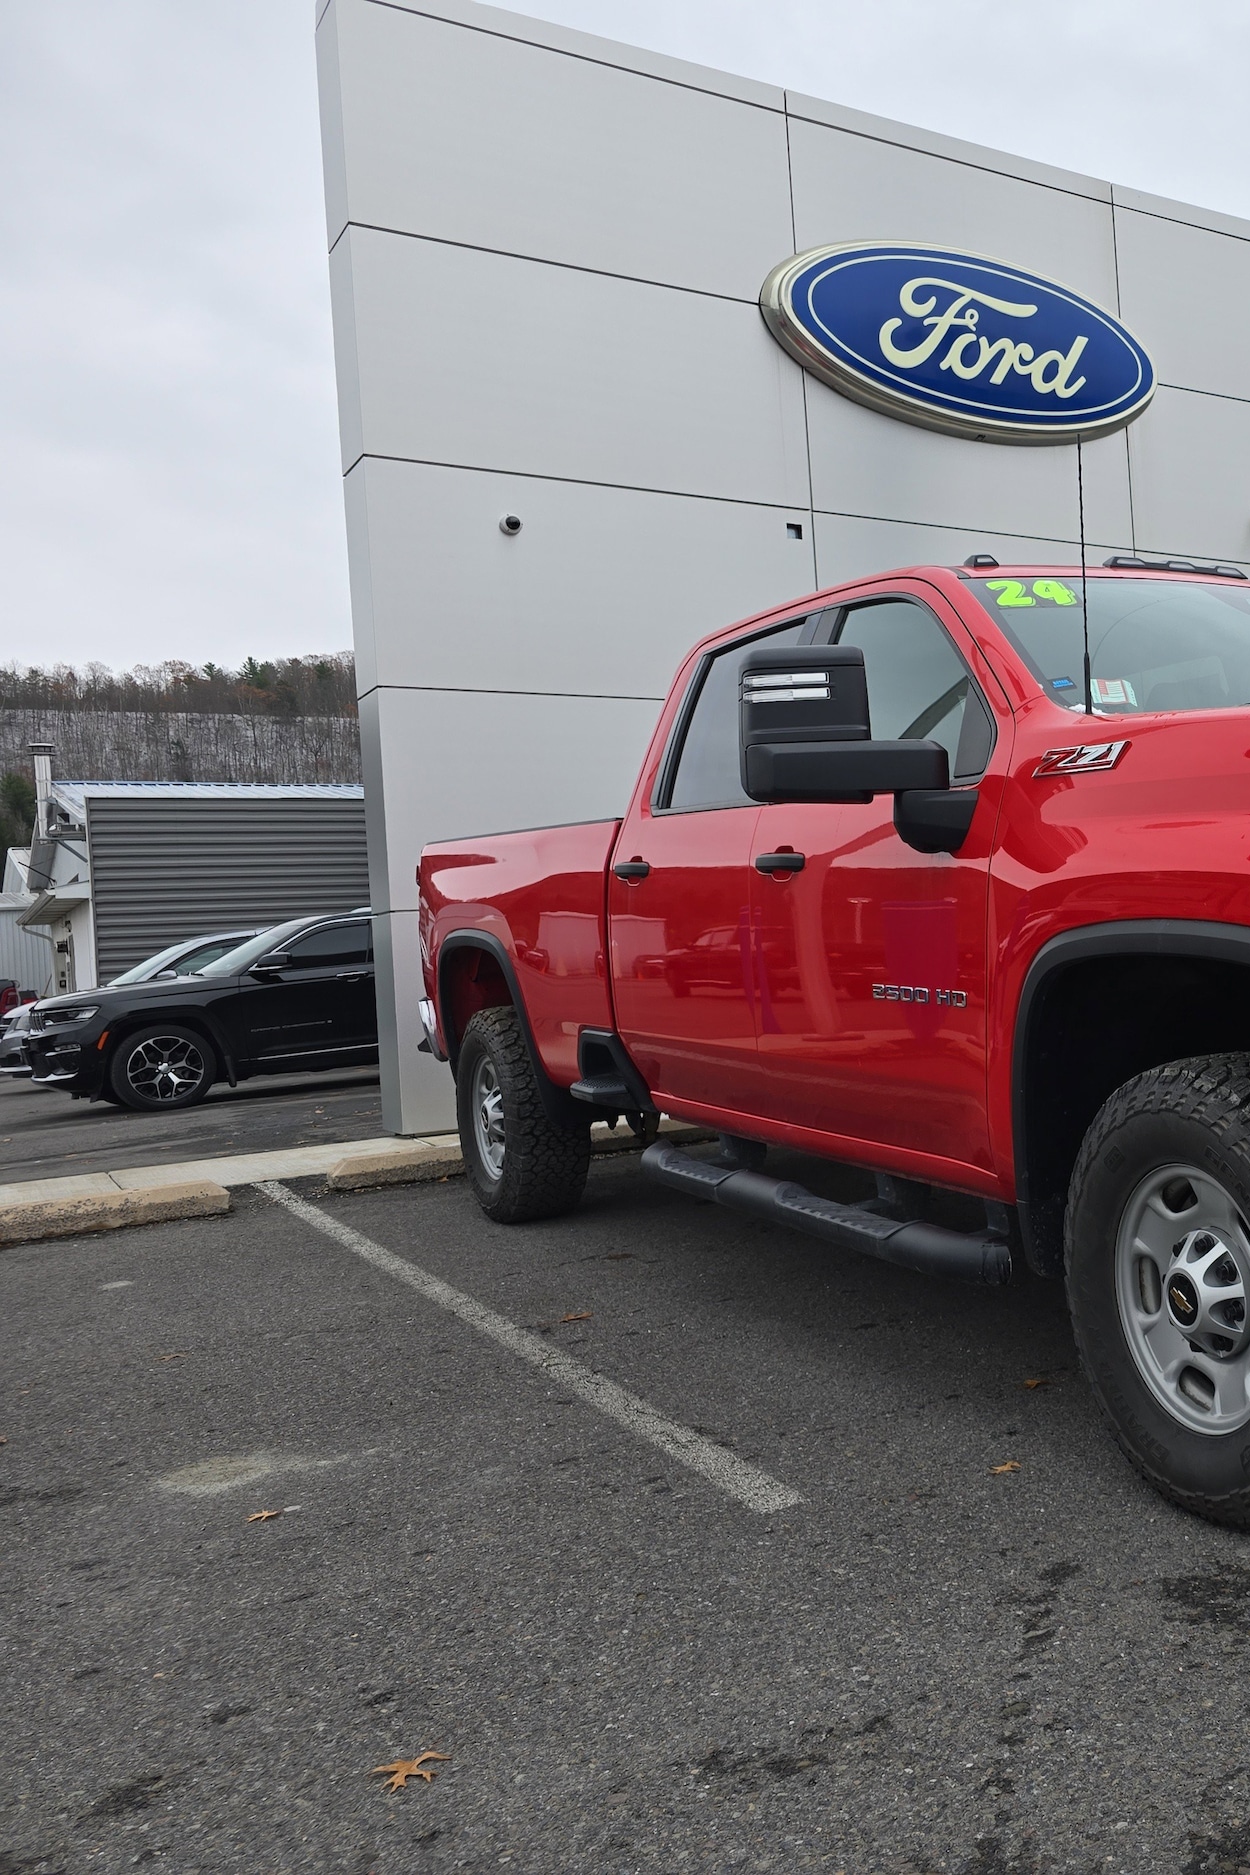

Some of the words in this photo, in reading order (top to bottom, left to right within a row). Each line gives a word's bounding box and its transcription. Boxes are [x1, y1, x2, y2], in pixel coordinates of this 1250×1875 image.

[879, 277, 1088, 399] Ford
[984, 578, 1078, 608] 24
[1032, 739, 1131, 778] Z71
[871, 983, 930, 1003] 2500
[935, 988, 967, 1008] HD
